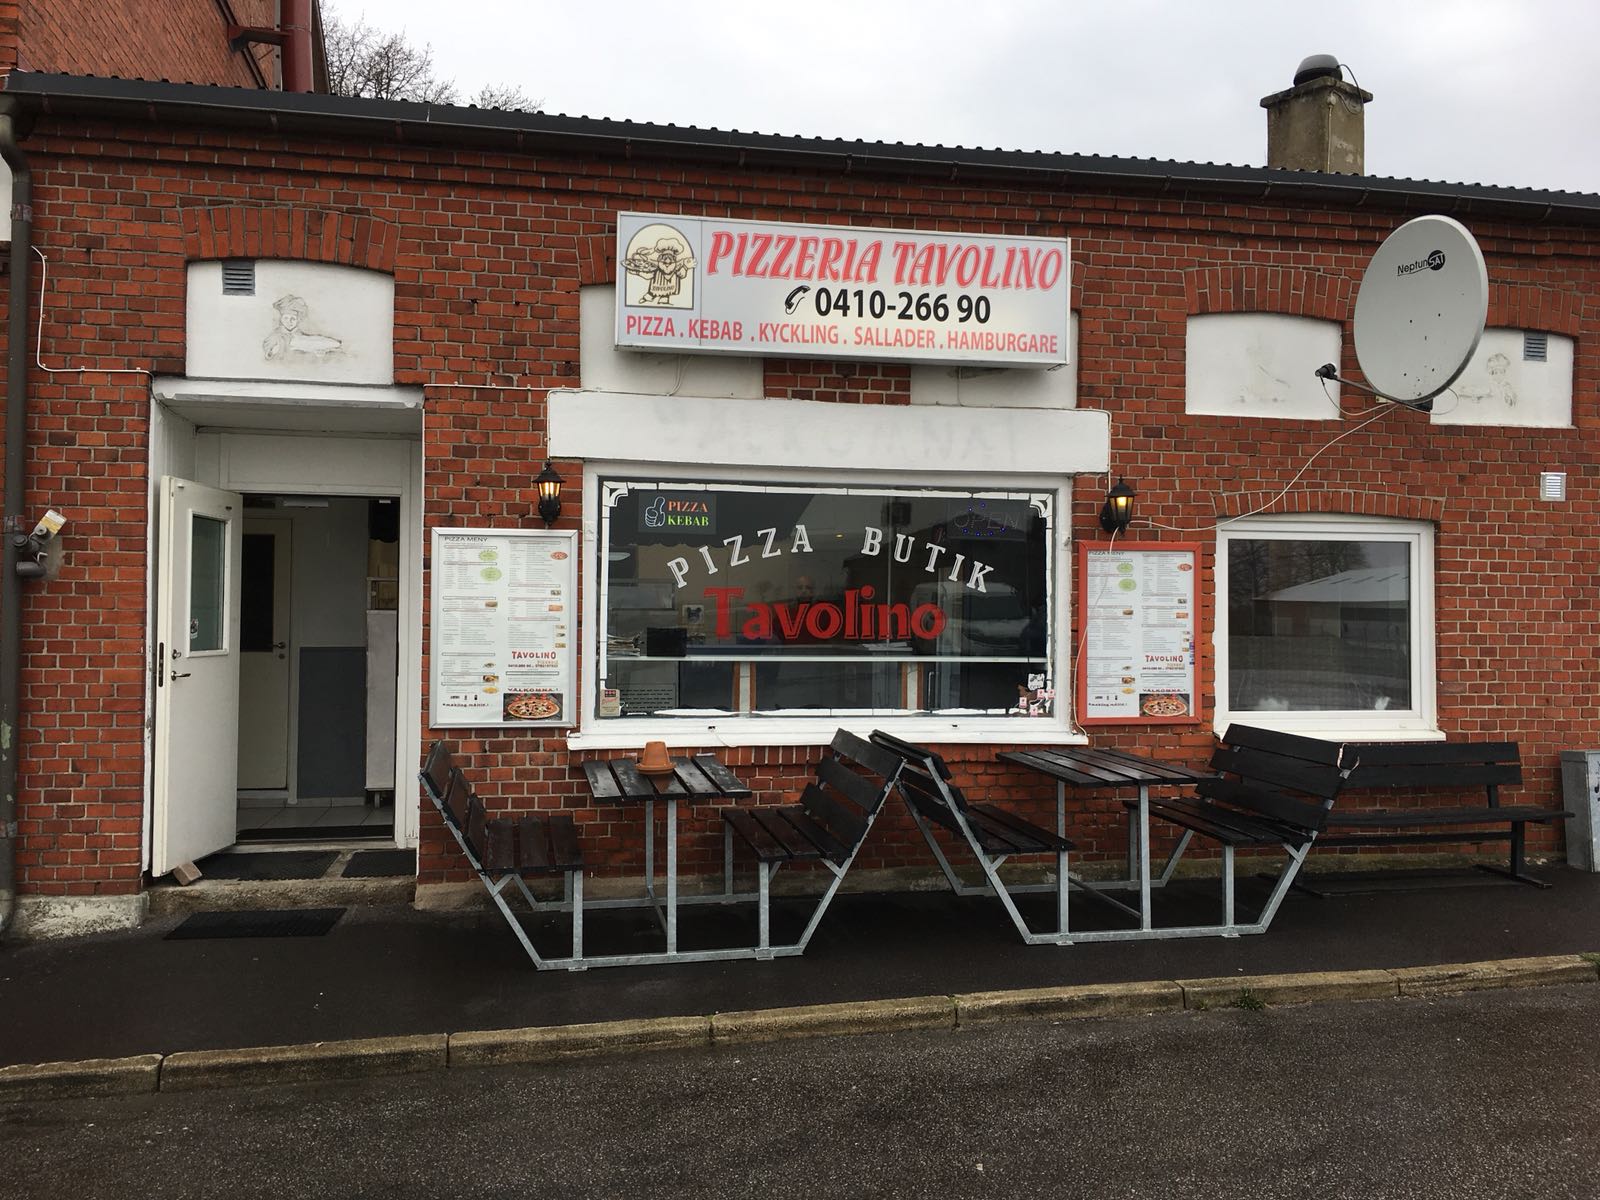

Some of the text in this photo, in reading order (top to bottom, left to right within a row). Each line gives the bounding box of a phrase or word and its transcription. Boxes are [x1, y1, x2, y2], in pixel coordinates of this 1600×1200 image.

[708, 231, 1063, 291] PIZZERIA TAVOLINO
[815, 287, 991, 324] 0410-266 90
[626, 316, 1058, 354] PIZZA KEBAB KYCKLING SALLADER HAMBURGARE
[667, 514, 709, 527] KEBAB
[668, 500, 709, 512] PIZZA
[667, 525, 994, 594] PIZZA BUTIK
[704, 585, 947, 640] Tavolino
[511, 651, 557, 660] TAVOLINO
[1145, 655, 1184, 663] TAVOLINO
